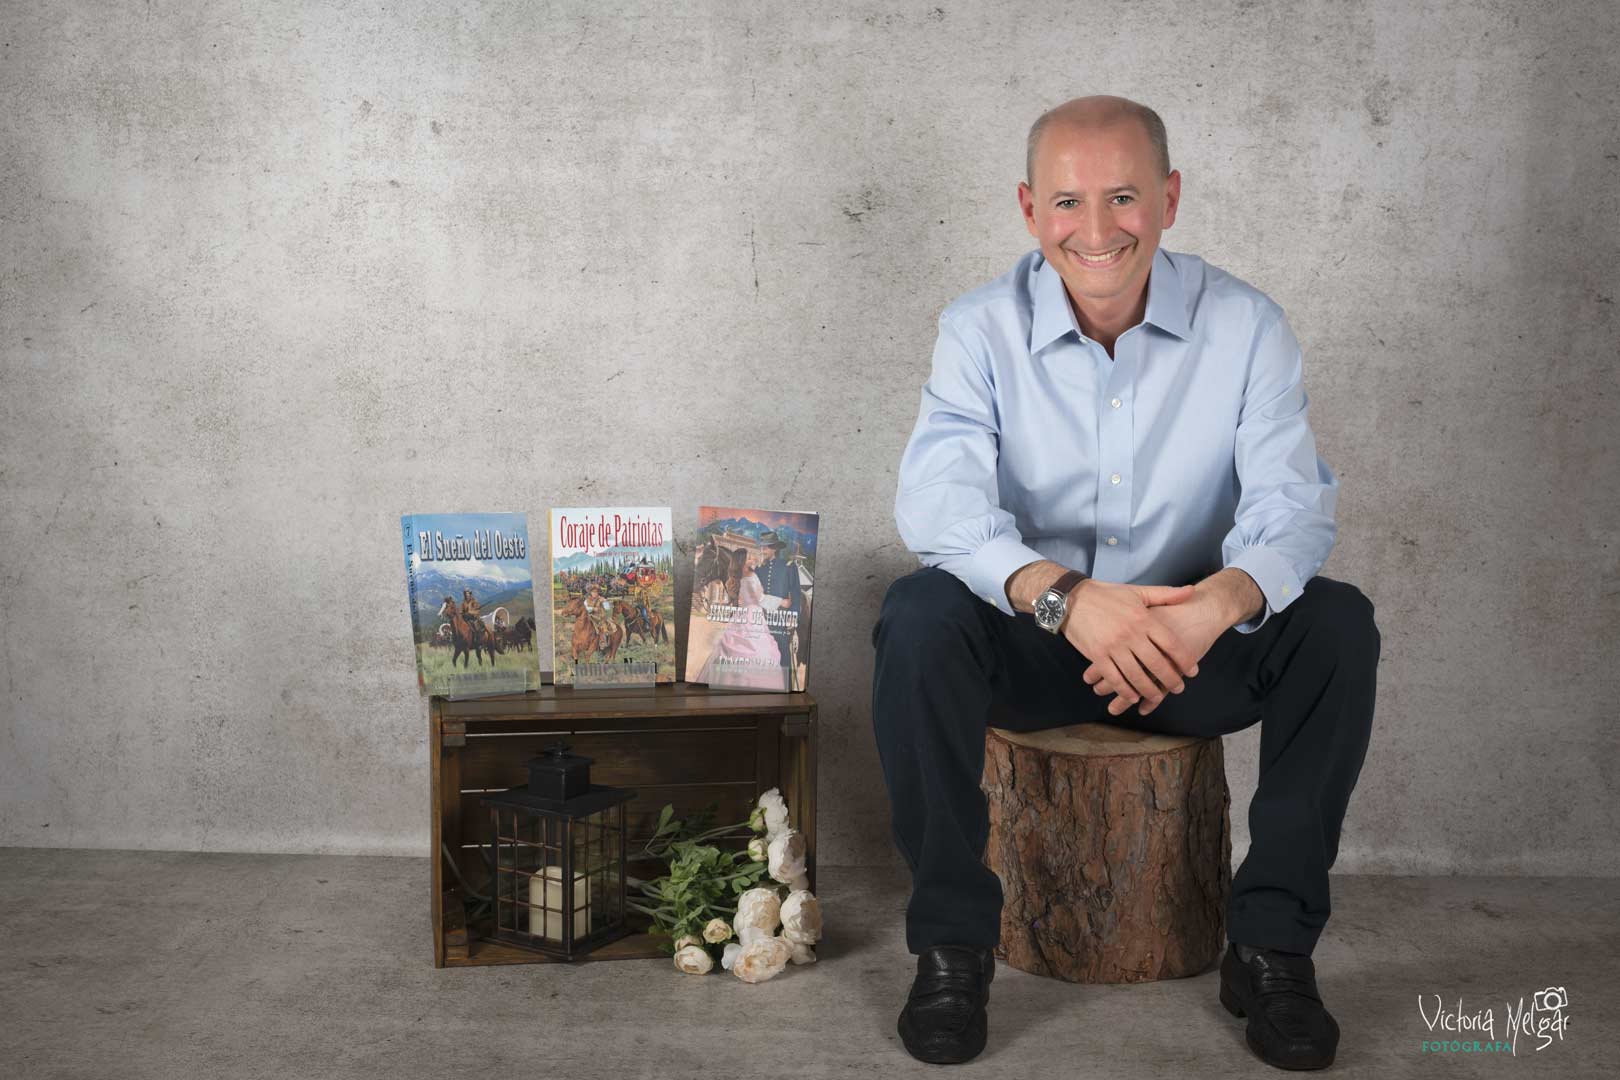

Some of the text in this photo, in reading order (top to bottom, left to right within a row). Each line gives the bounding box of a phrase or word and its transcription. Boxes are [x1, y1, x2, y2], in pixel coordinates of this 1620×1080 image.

[419, 529, 526, 561] El Sueño del Oeste
[560, 514, 664, 553] Coraje de Patriotas
[766, 608, 799, 628] HONOR
